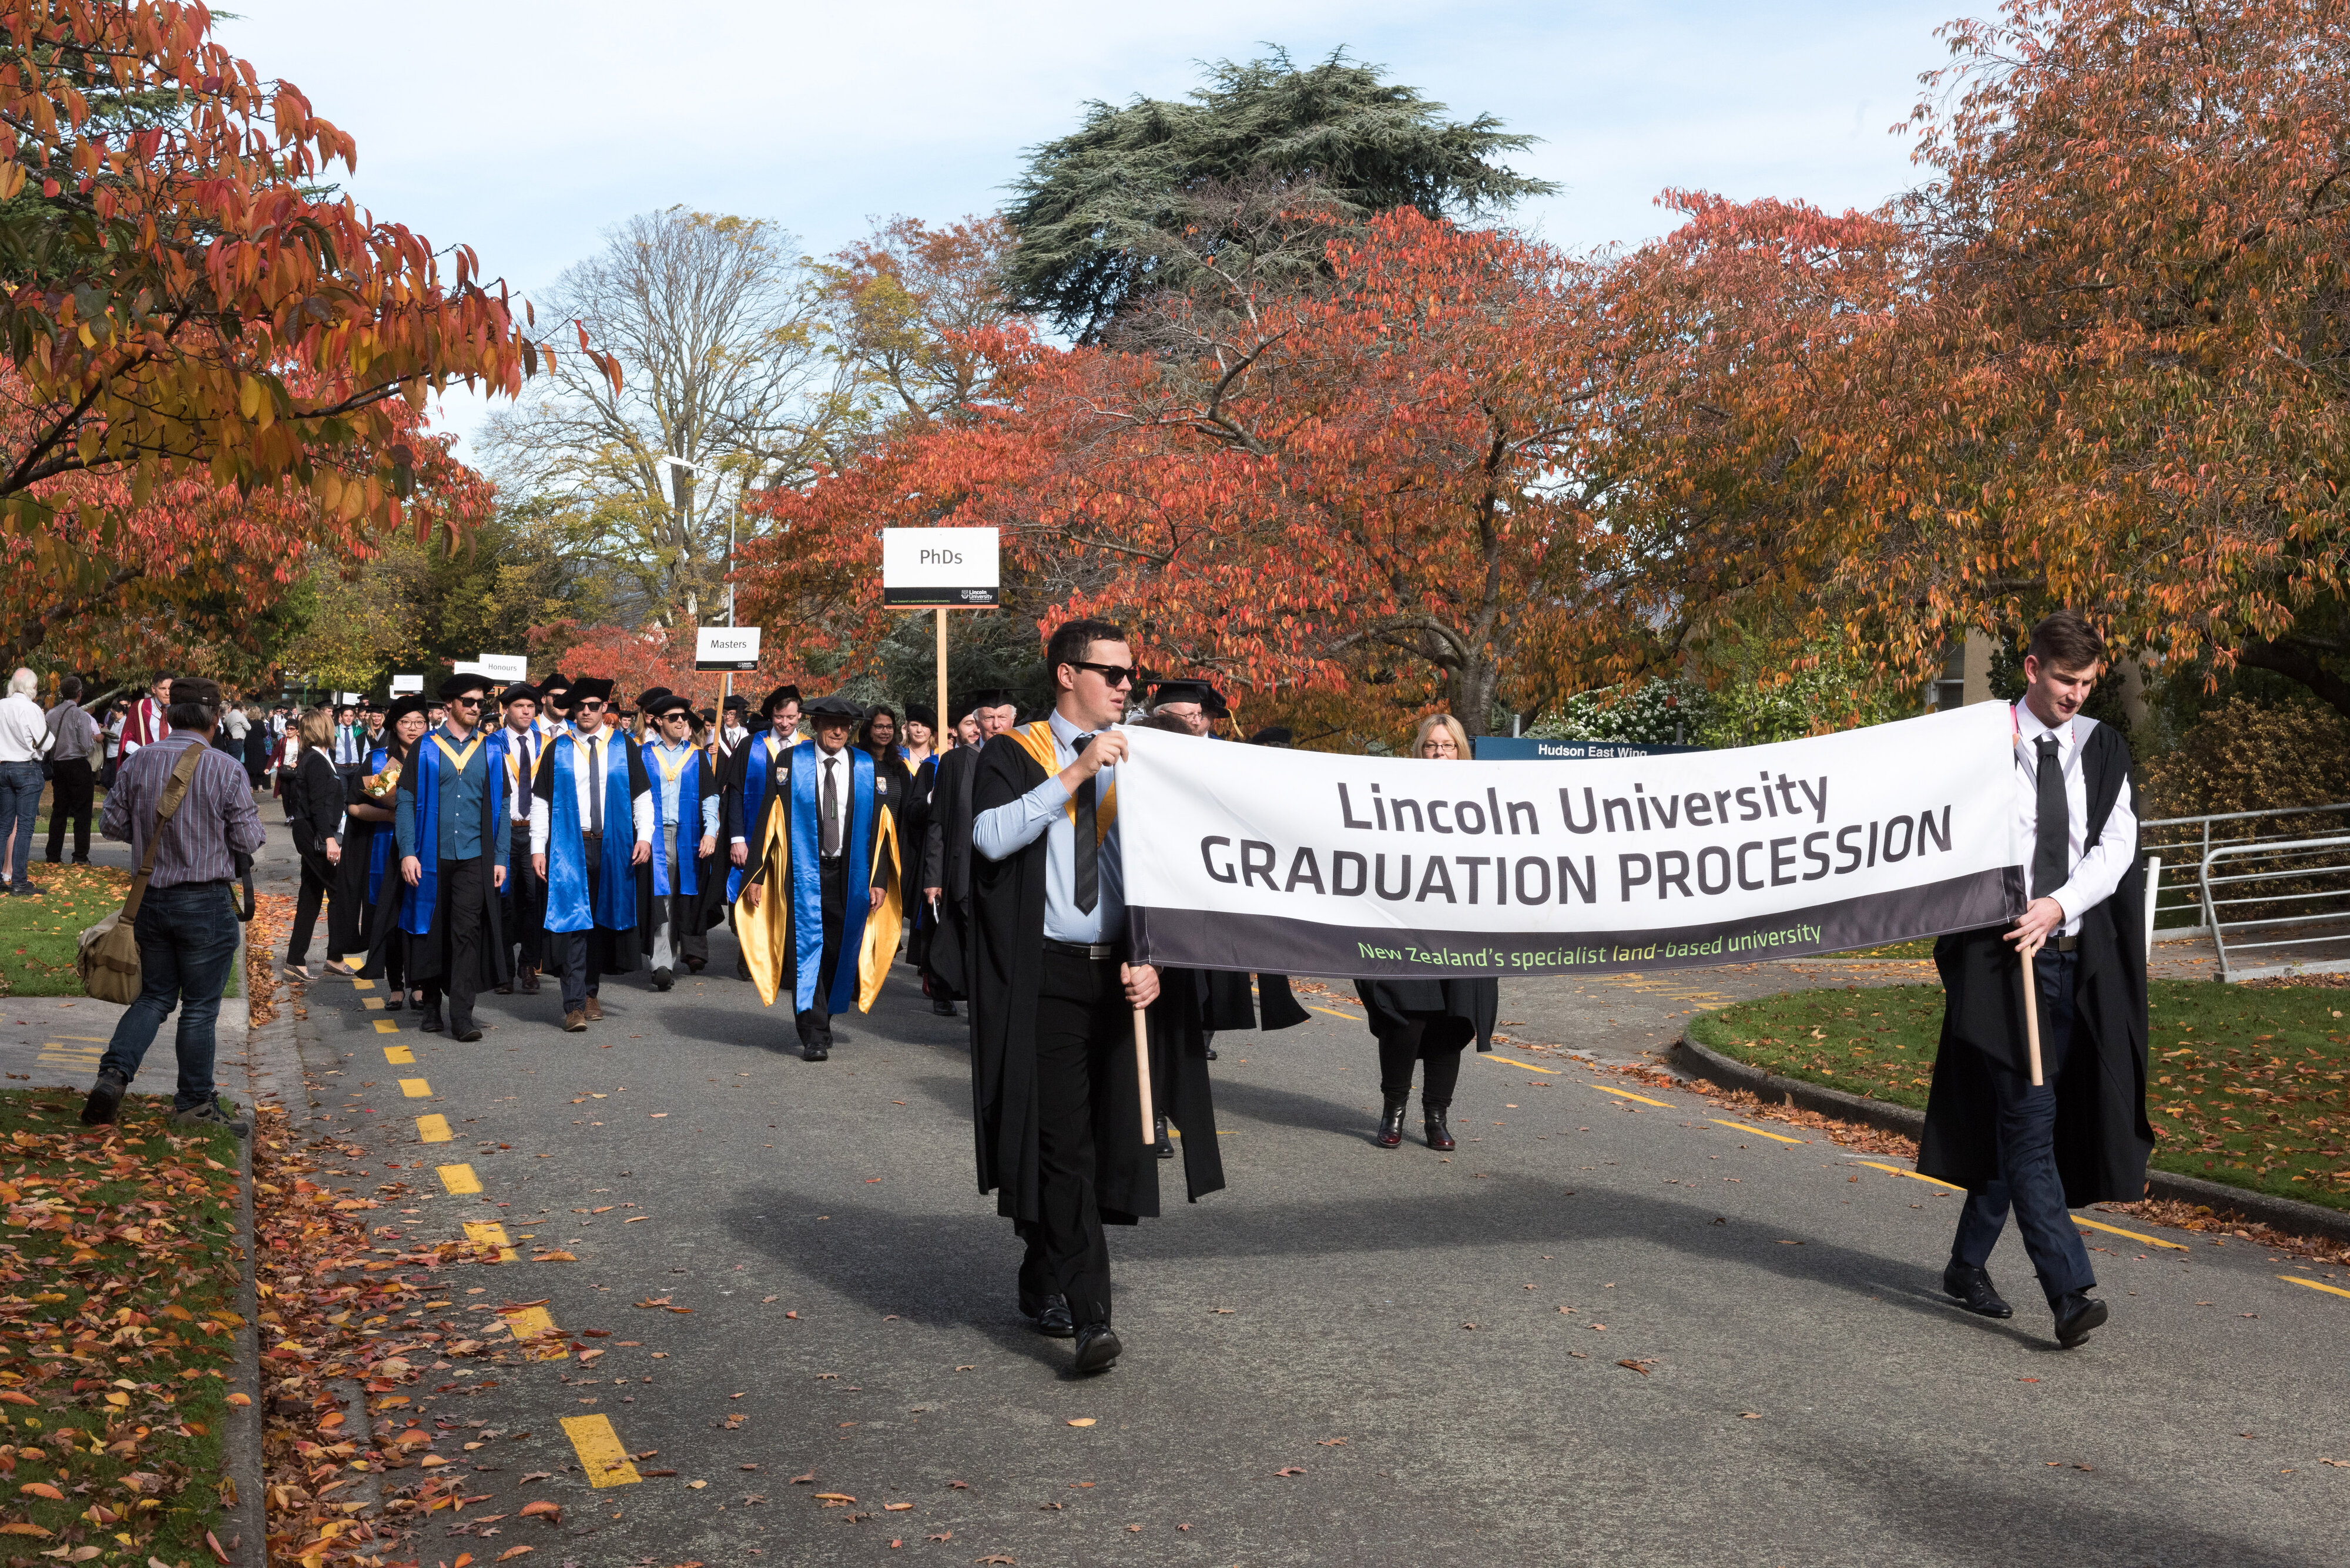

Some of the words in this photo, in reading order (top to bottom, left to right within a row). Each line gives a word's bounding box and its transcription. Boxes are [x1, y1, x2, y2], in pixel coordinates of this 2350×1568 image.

[920, 549, 963, 565] PhDs
[710, 640, 747, 649] Masters
[488, 663, 517, 671] Honours
[1538, 744, 1584, 757] Hudson
[1588, 746, 1614, 757] East
[1337, 782, 1540, 835] Lincoln
[1559, 771, 1827, 834] University
[1201, 835, 1597, 906] GRADUATION
[1618, 804, 1952, 902] PROCESSION
[1357, 942, 1402, 961] New
[1405, 947, 1504, 967] Zealand's
[1511, 947, 1607, 971] specialist
[1613, 936, 1722, 962] land-based
[1728, 924, 1821, 952] university
